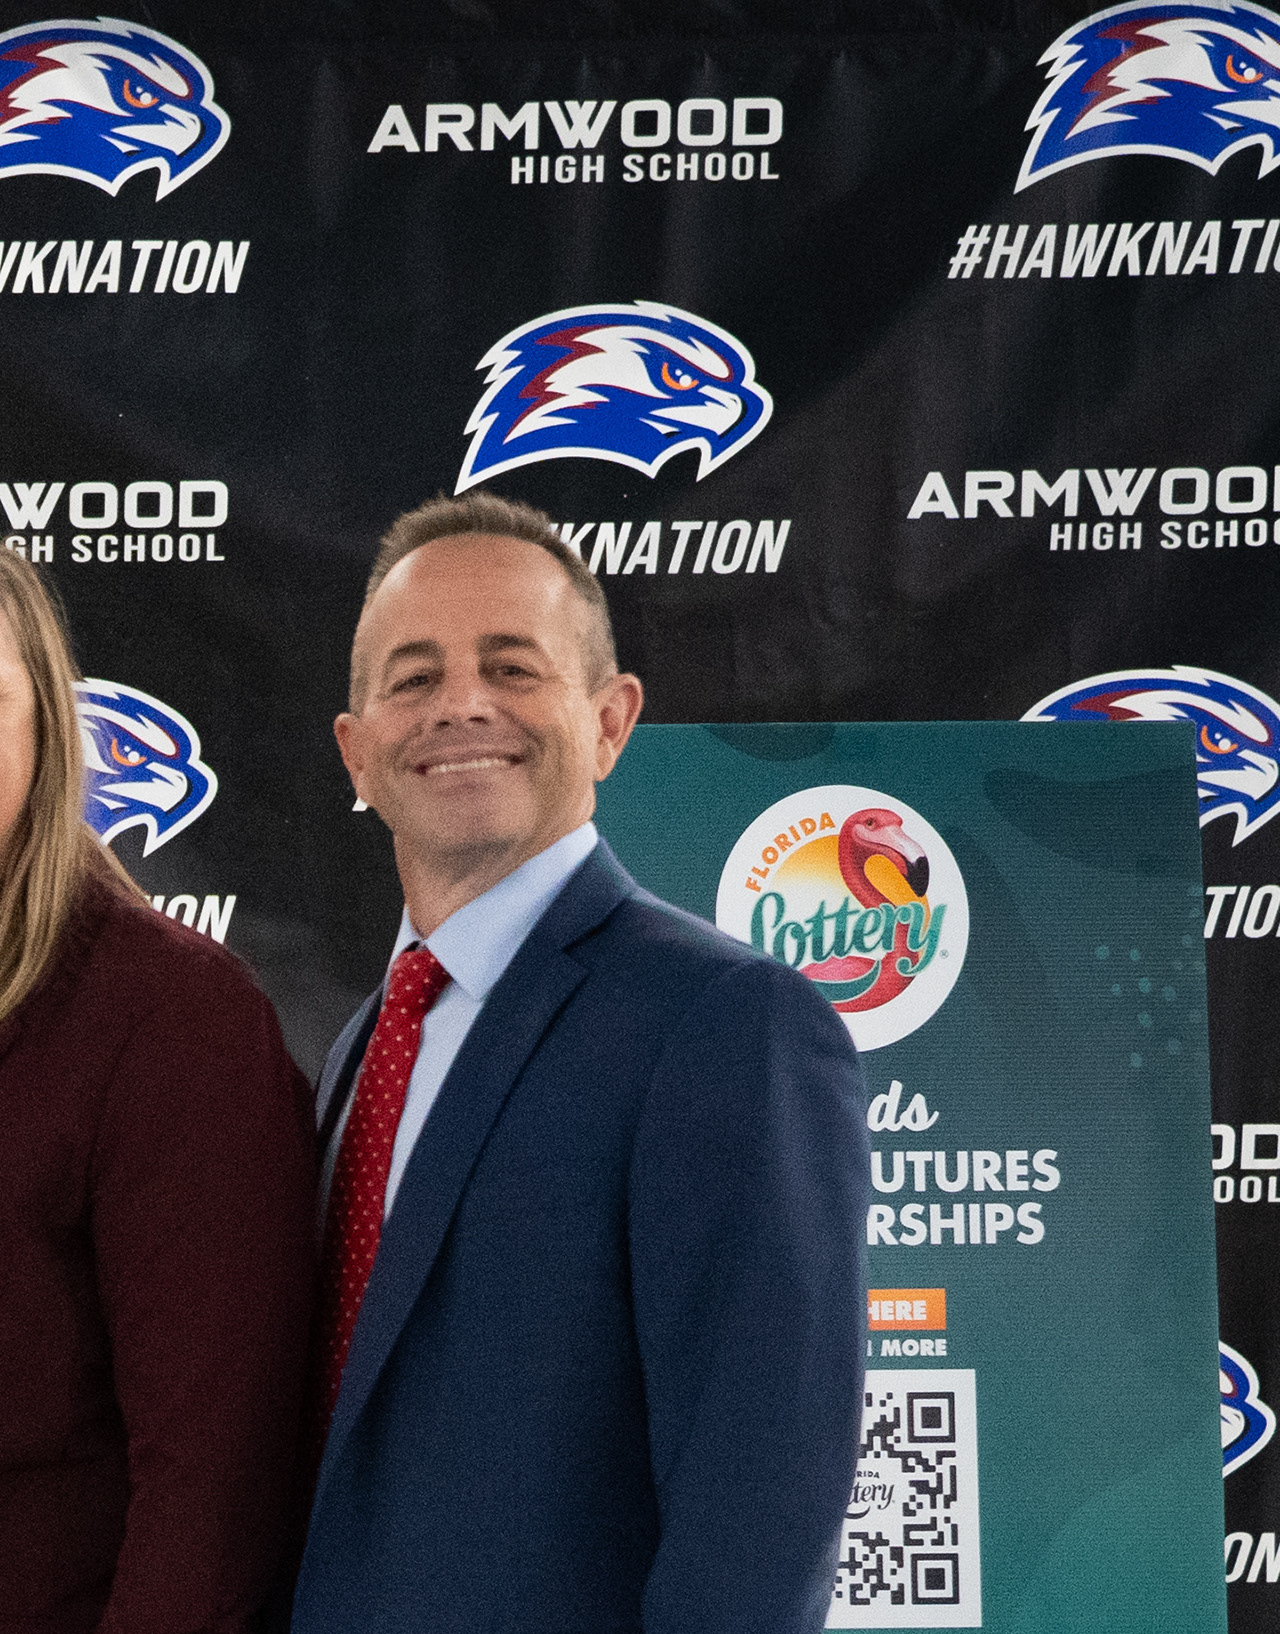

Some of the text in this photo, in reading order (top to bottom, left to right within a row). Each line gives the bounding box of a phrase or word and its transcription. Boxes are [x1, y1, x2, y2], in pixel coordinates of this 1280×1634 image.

[368, 98, 782, 152] ARMWOOD
[512, 153, 778, 183] HIGH SCHOOL
[949, 220, 1280, 278] #HAWKNATI
[908, 466, 1280, 518] ARMWOO
[72, 534, 224, 562] SCHOOL
[550, 519, 791, 575] KNATION
[1051, 523, 1141, 550] HIGH
[744, 810, 835, 893] FLORIDA
[750, 890, 947, 977] Lottery
[1204, 884, 1280, 939] TIO
[870, 1150, 1061, 1192] UTURES
[866, 1201, 1045, 1246] RSHIPS
[880, 1339, 947, 1357] MORE
